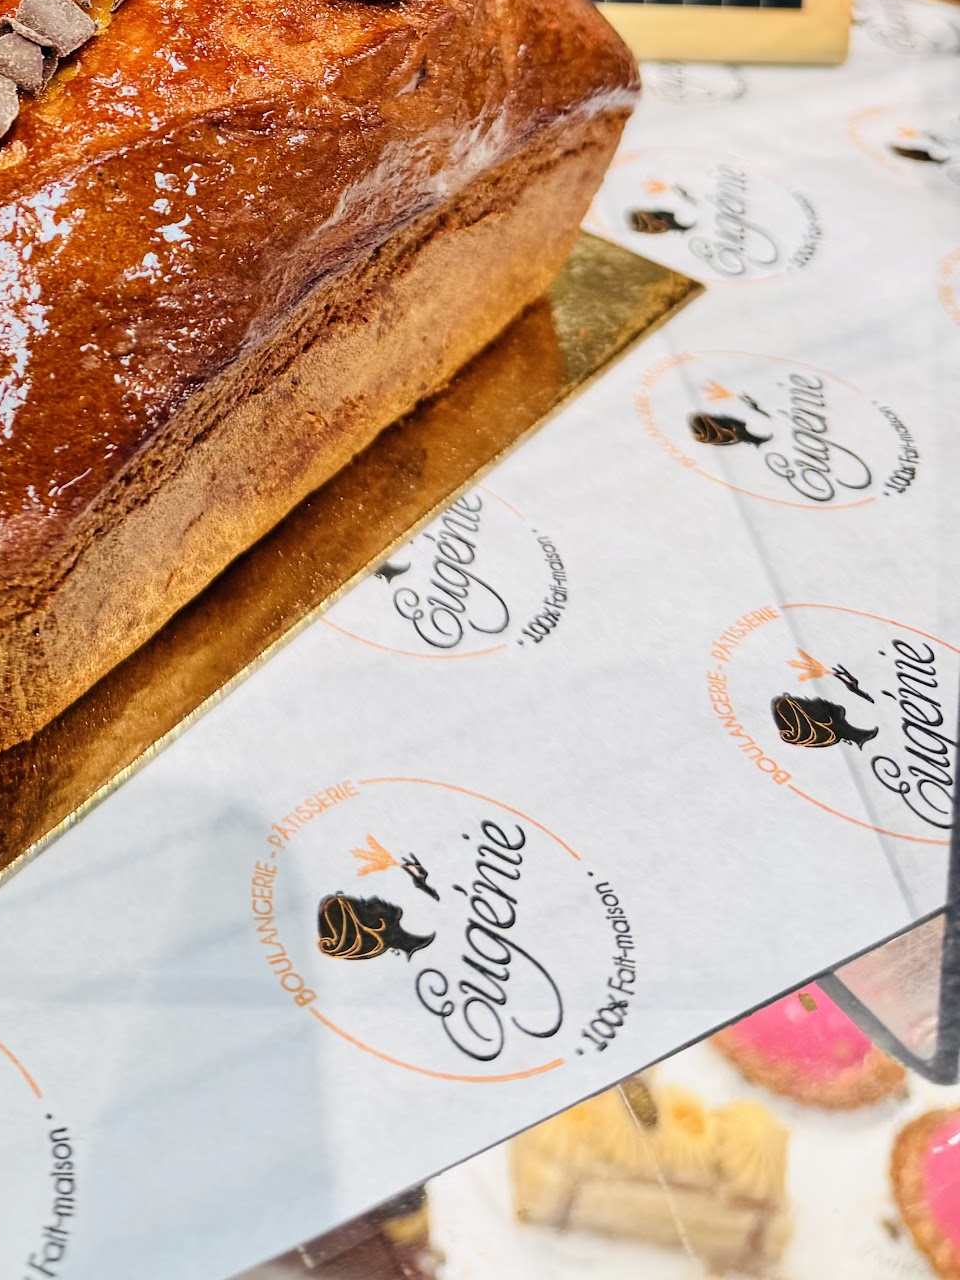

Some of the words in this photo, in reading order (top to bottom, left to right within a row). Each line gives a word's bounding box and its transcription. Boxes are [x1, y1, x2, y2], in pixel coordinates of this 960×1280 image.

[764, 373, 872, 502] Eugénie
[711, 604, 781, 663] PÂTISSERIE
[707, 671, 792, 785] BOULANGERIE
[267, 780, 360, 850] PÂTISSERIE
[251, 860, 318, 1007] BOULANGERIE
[416, 819, 563, 1061] Eugénie
[595, 881, 636, 996] Fait-maison
[581, 993, 629, 1052] 100%
